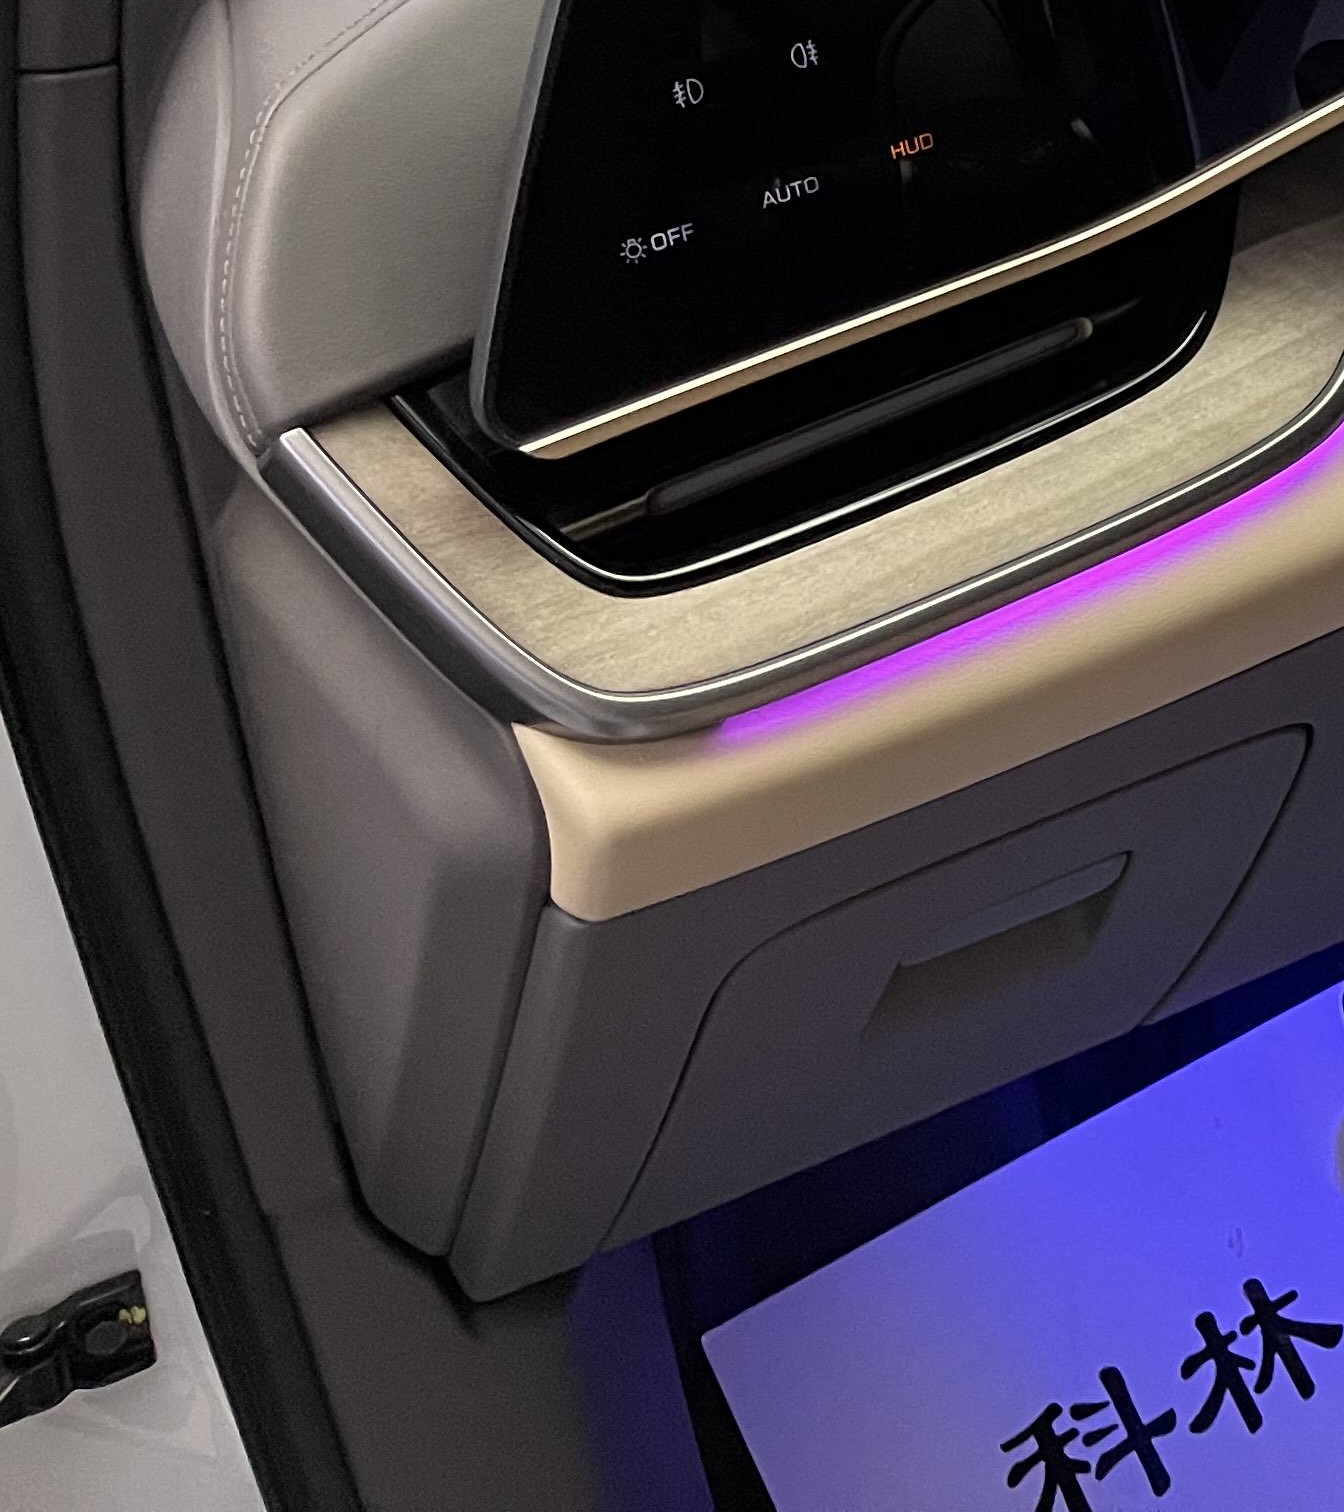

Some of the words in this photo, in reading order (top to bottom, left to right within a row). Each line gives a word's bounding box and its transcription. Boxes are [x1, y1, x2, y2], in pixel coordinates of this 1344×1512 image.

[890, 133, 934, 160] HUD
[762, 176, 820, 209] AUTO
[650, 223, 694, 251] OFF
